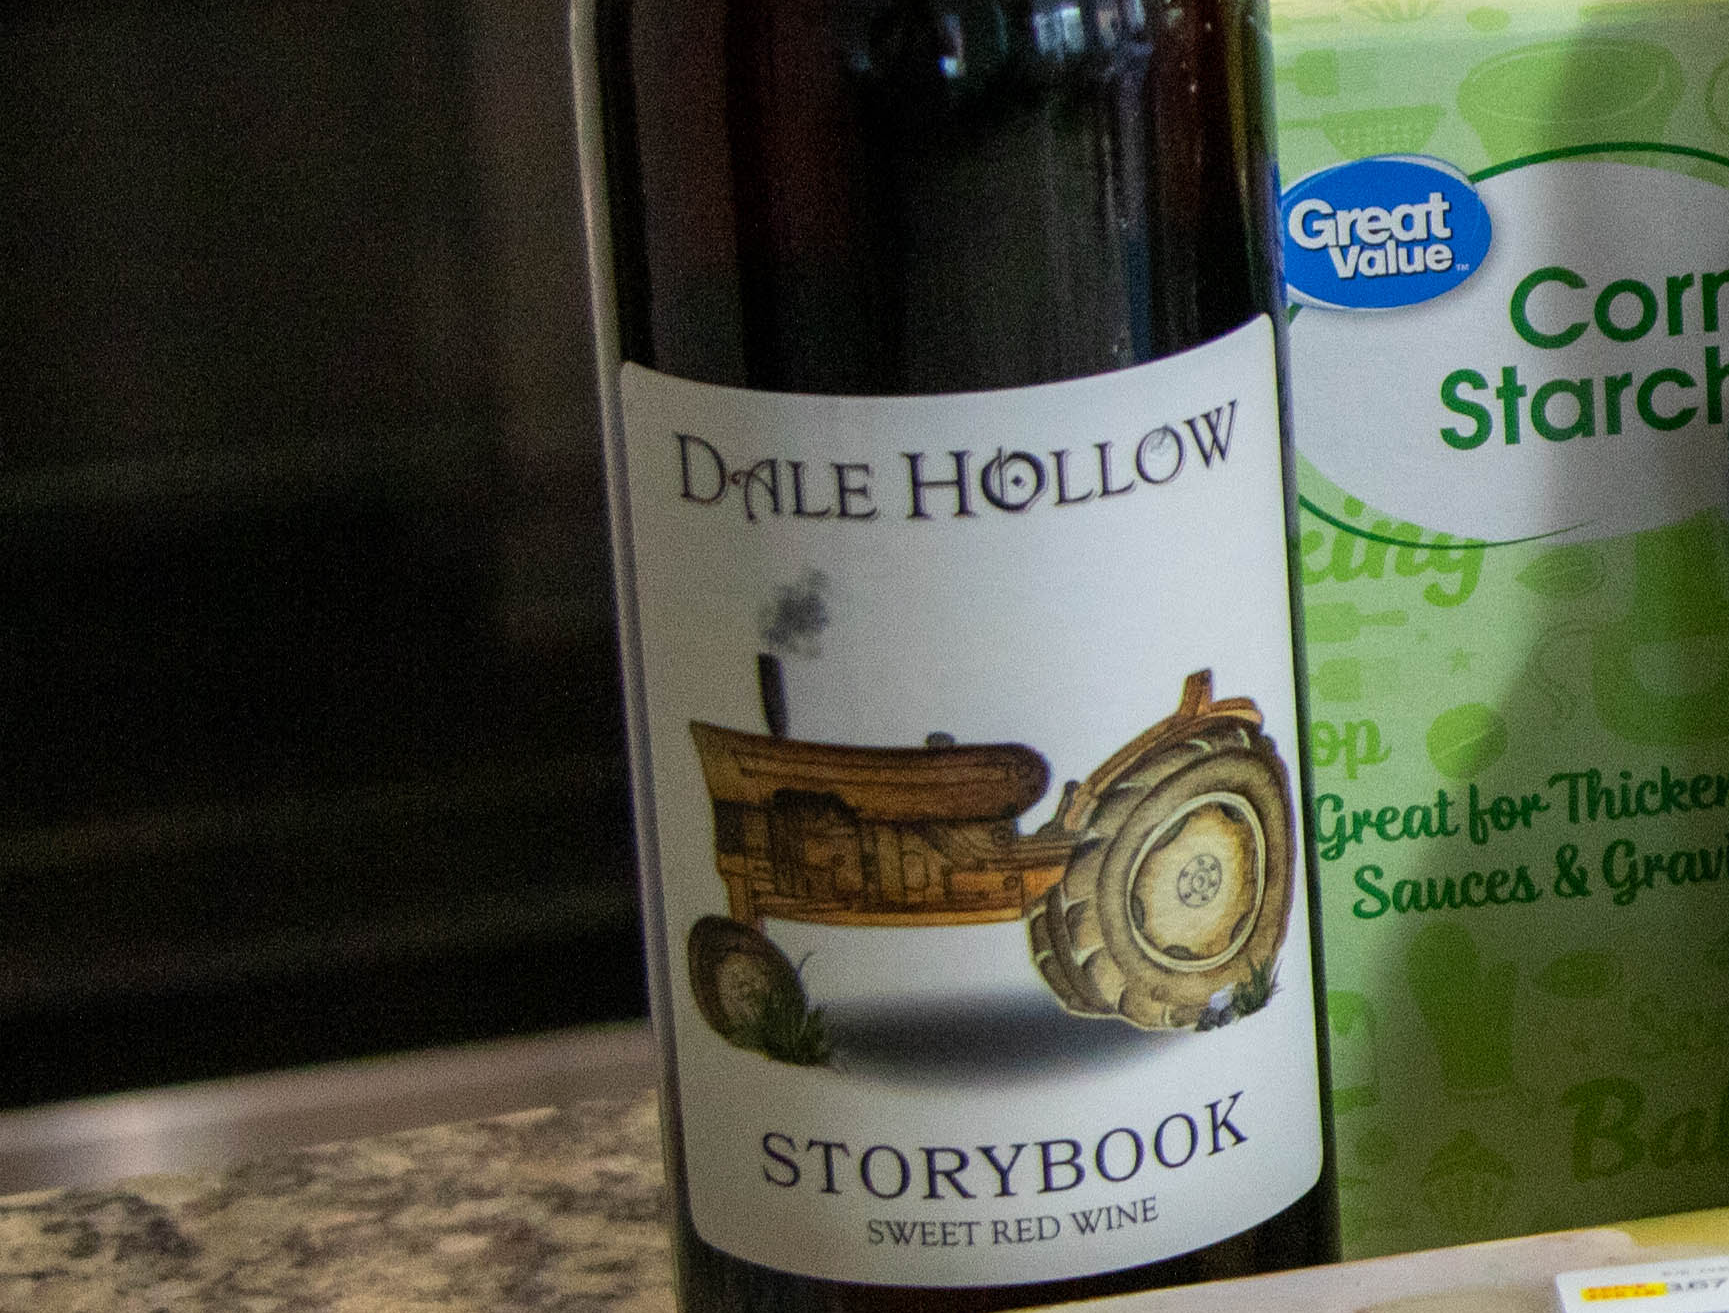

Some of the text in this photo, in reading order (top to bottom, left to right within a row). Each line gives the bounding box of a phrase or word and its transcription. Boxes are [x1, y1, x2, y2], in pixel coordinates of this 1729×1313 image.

[1288, 192, 1452, 250] Great
[1329, 241, 1453, 279] Value
[1316, 789, 1461, 861] Great
[1468, 783, 1551, 846] for
[1351, 862, 1544, 920] Sauces
[1553, 842, 1594, 899] &
[759, 1090, 1250, 1204] STORYBOOK
[866, 1196, 1161, 1249] SWEET RED WINE
